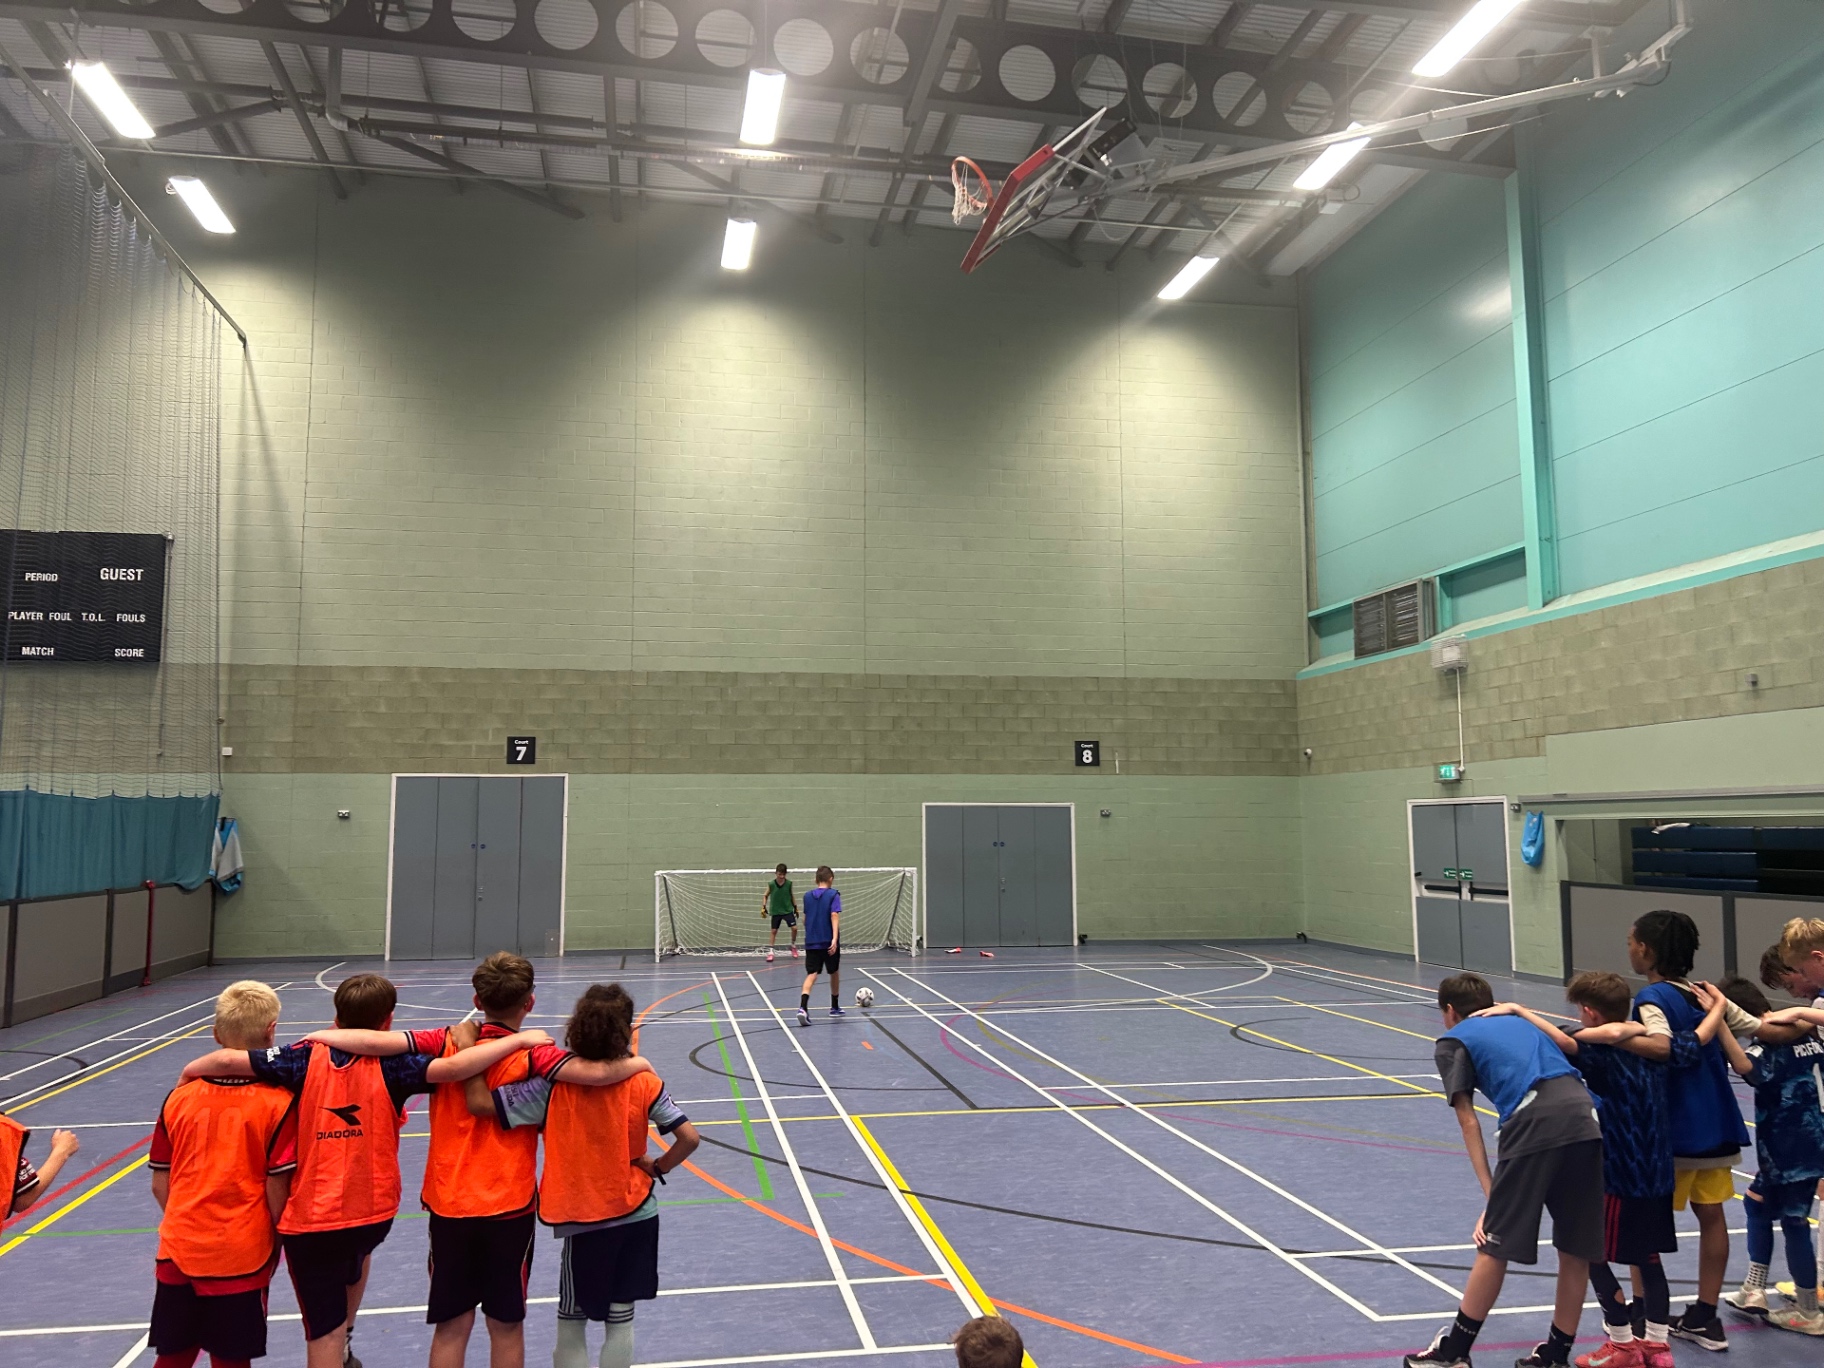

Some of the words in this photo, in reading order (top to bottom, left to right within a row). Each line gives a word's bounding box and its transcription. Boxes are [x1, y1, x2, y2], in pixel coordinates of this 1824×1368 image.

[25, 573, 58, 582] PERIOD
[100, 568, 144, 581] GUEST
[8, 612, 43, 621] PLAYER
[49, 612, 72, 621] FOUL
[117, 614, 146, 623] FOULS
[22, 647, 54, 656] MATCH
[115, 649, 144, 657] SCORE
[516, 746, 527, 761] 7
[1082, 749, 1093, 764] 8
[316, 1129, 364, 1140] DIADORA
